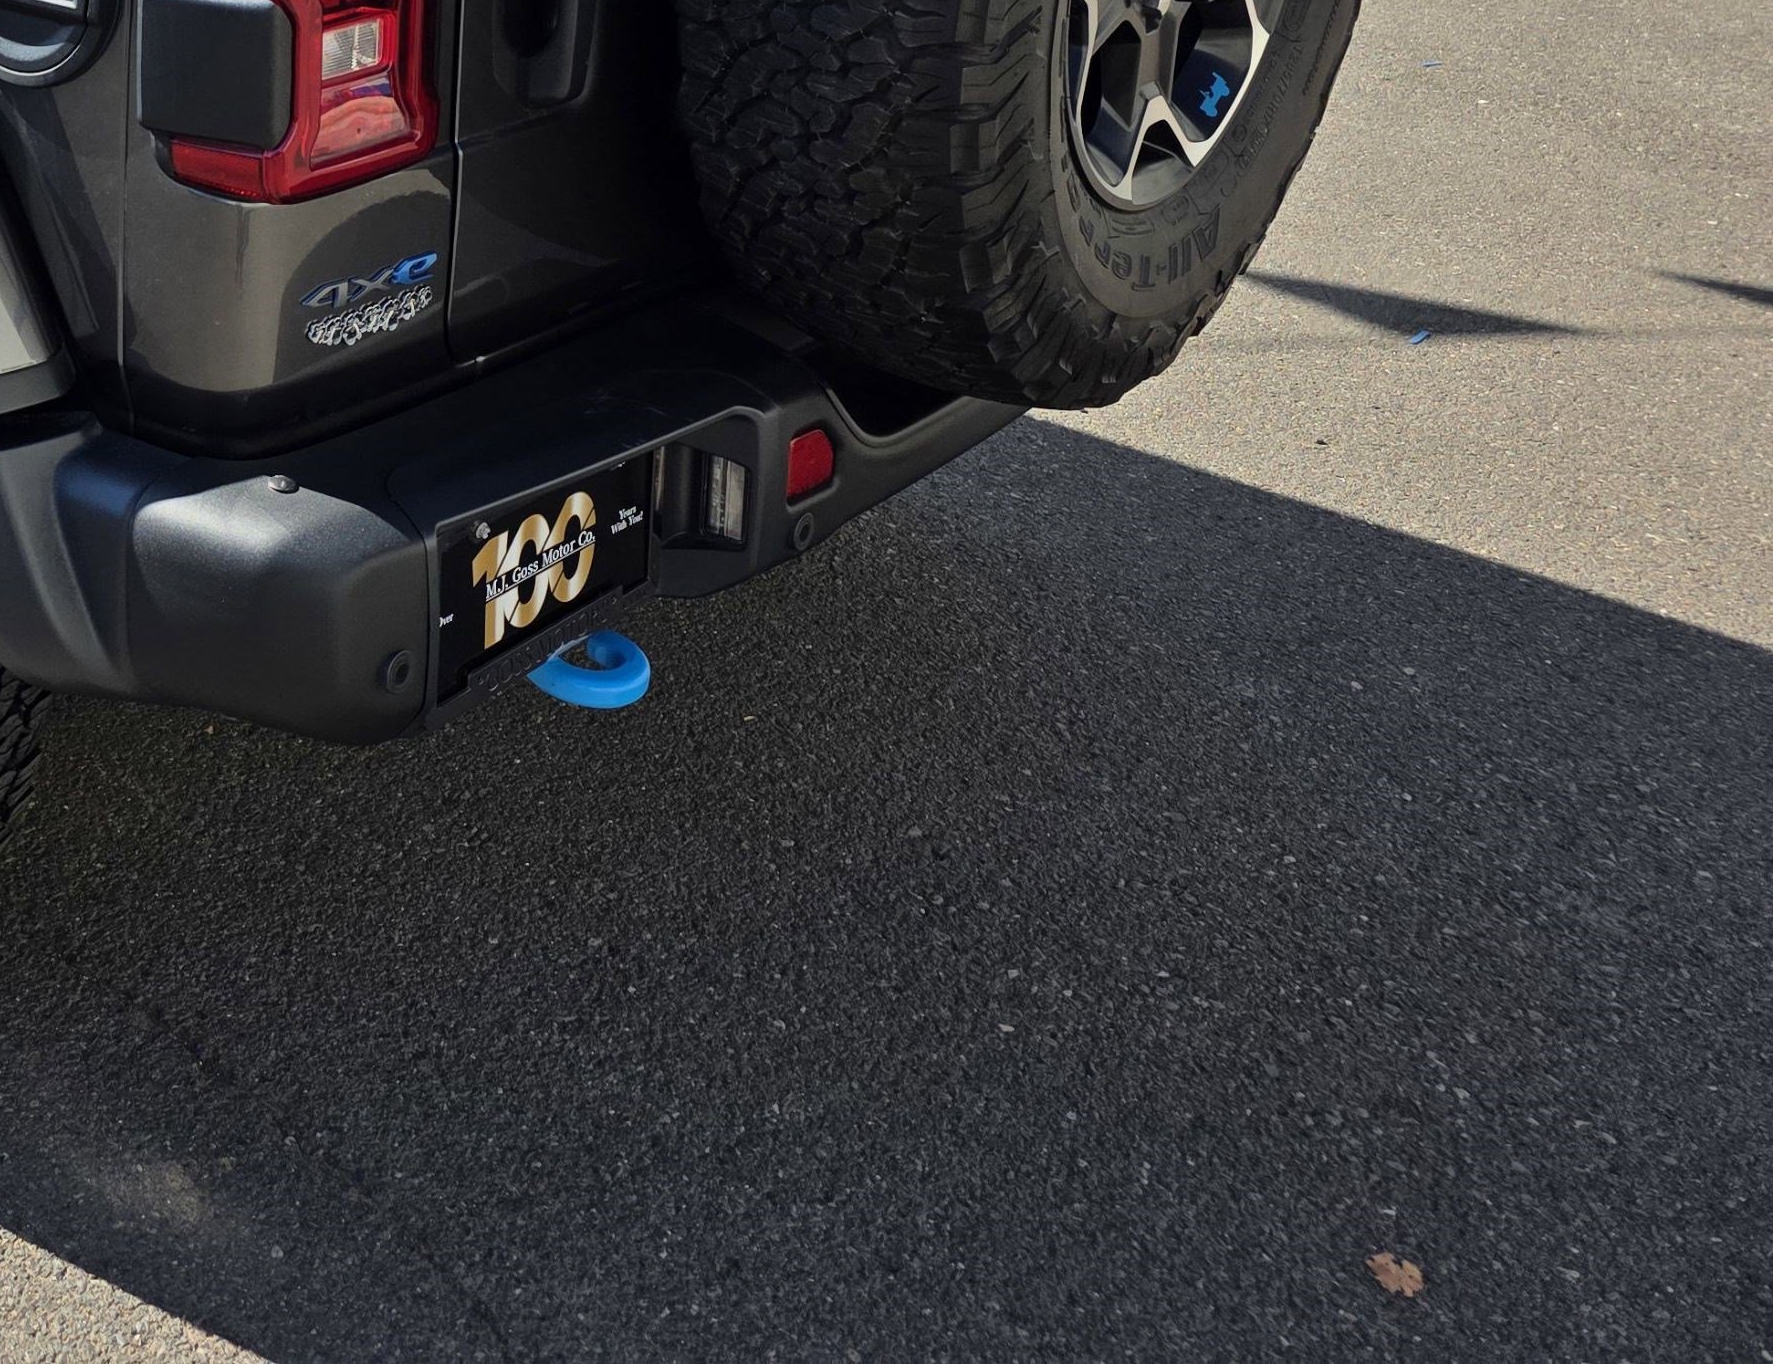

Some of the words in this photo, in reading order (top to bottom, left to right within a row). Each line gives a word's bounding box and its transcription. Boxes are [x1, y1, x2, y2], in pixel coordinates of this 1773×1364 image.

[471, 491, 596, 650] 100
[486, 575, 509, 600] M.J.
[512, 559, 539, 583] Goss
[542, 539, 576, 569] Motor
[578, 530, 596, 548] Co.
